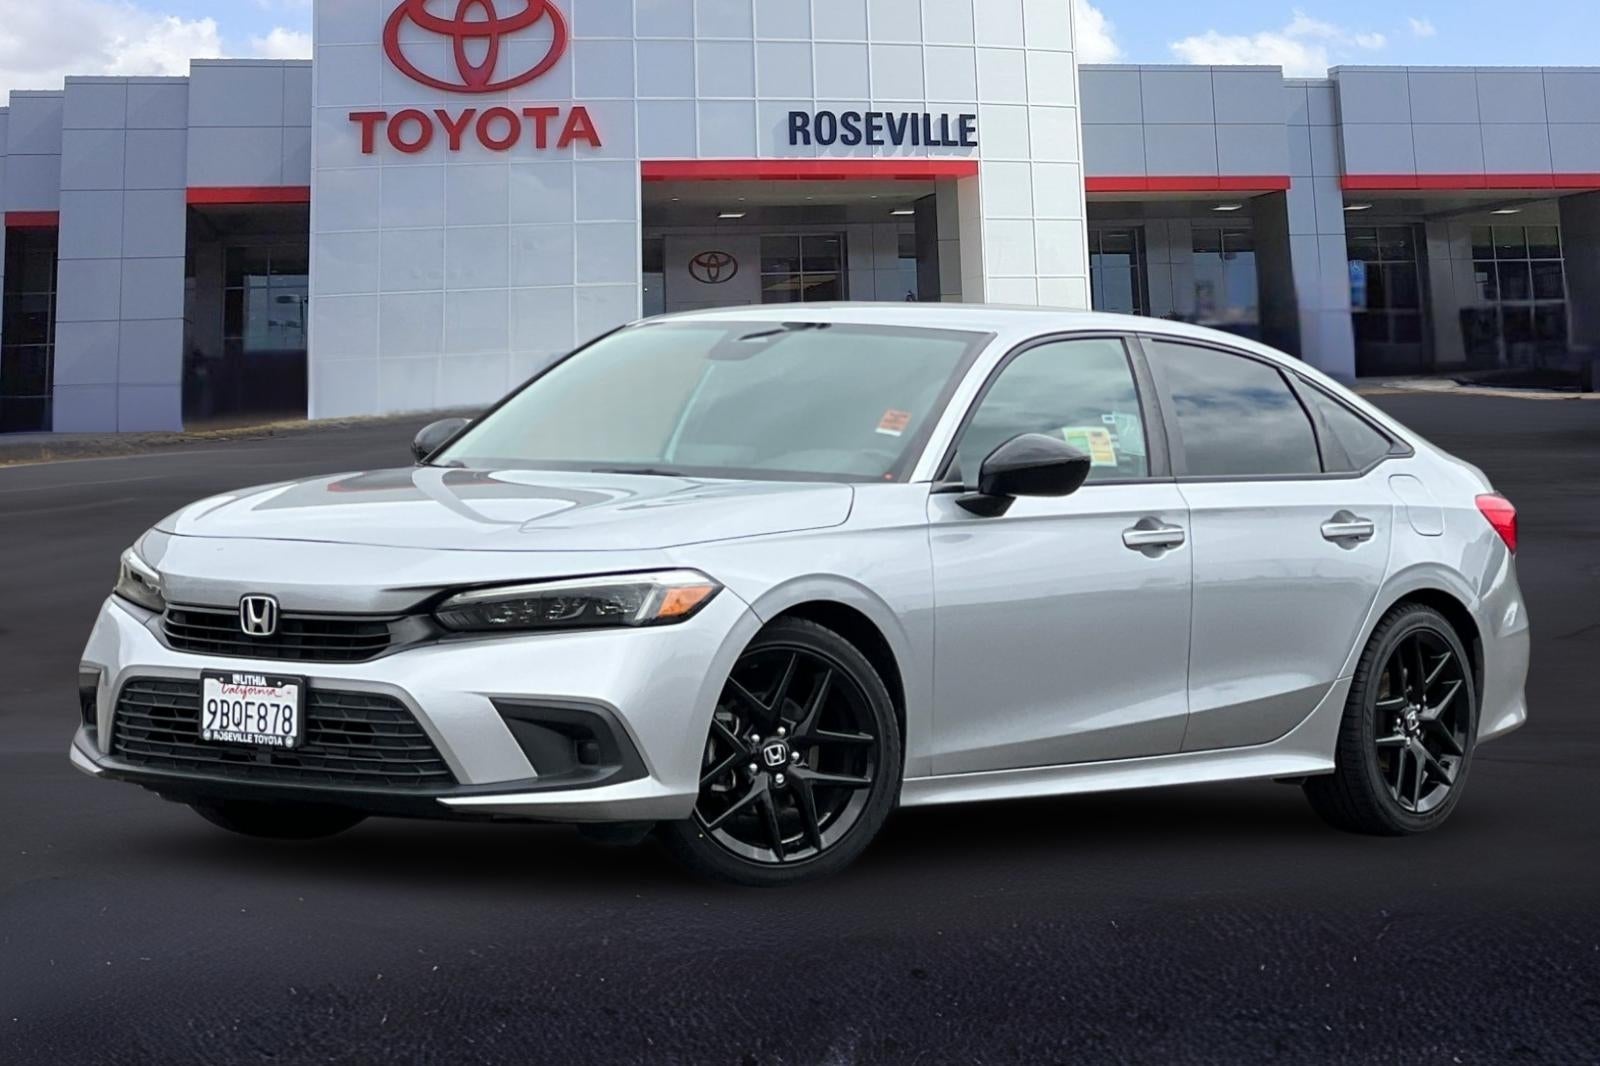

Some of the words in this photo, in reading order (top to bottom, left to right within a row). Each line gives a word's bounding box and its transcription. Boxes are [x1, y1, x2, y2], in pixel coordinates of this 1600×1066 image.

[349, 105, 602, 154] TOYOTA
[788, 110, 978, 147] ROSEVILLE
[221, 683, 282, 699] California
[240, 674, 267, 686] LITHIA
[206, 699, 293, 735] 9BQF878
[213, 731, 253, 743] ROSEVILLE
[254, 734, 283, 746] TOYOTA
